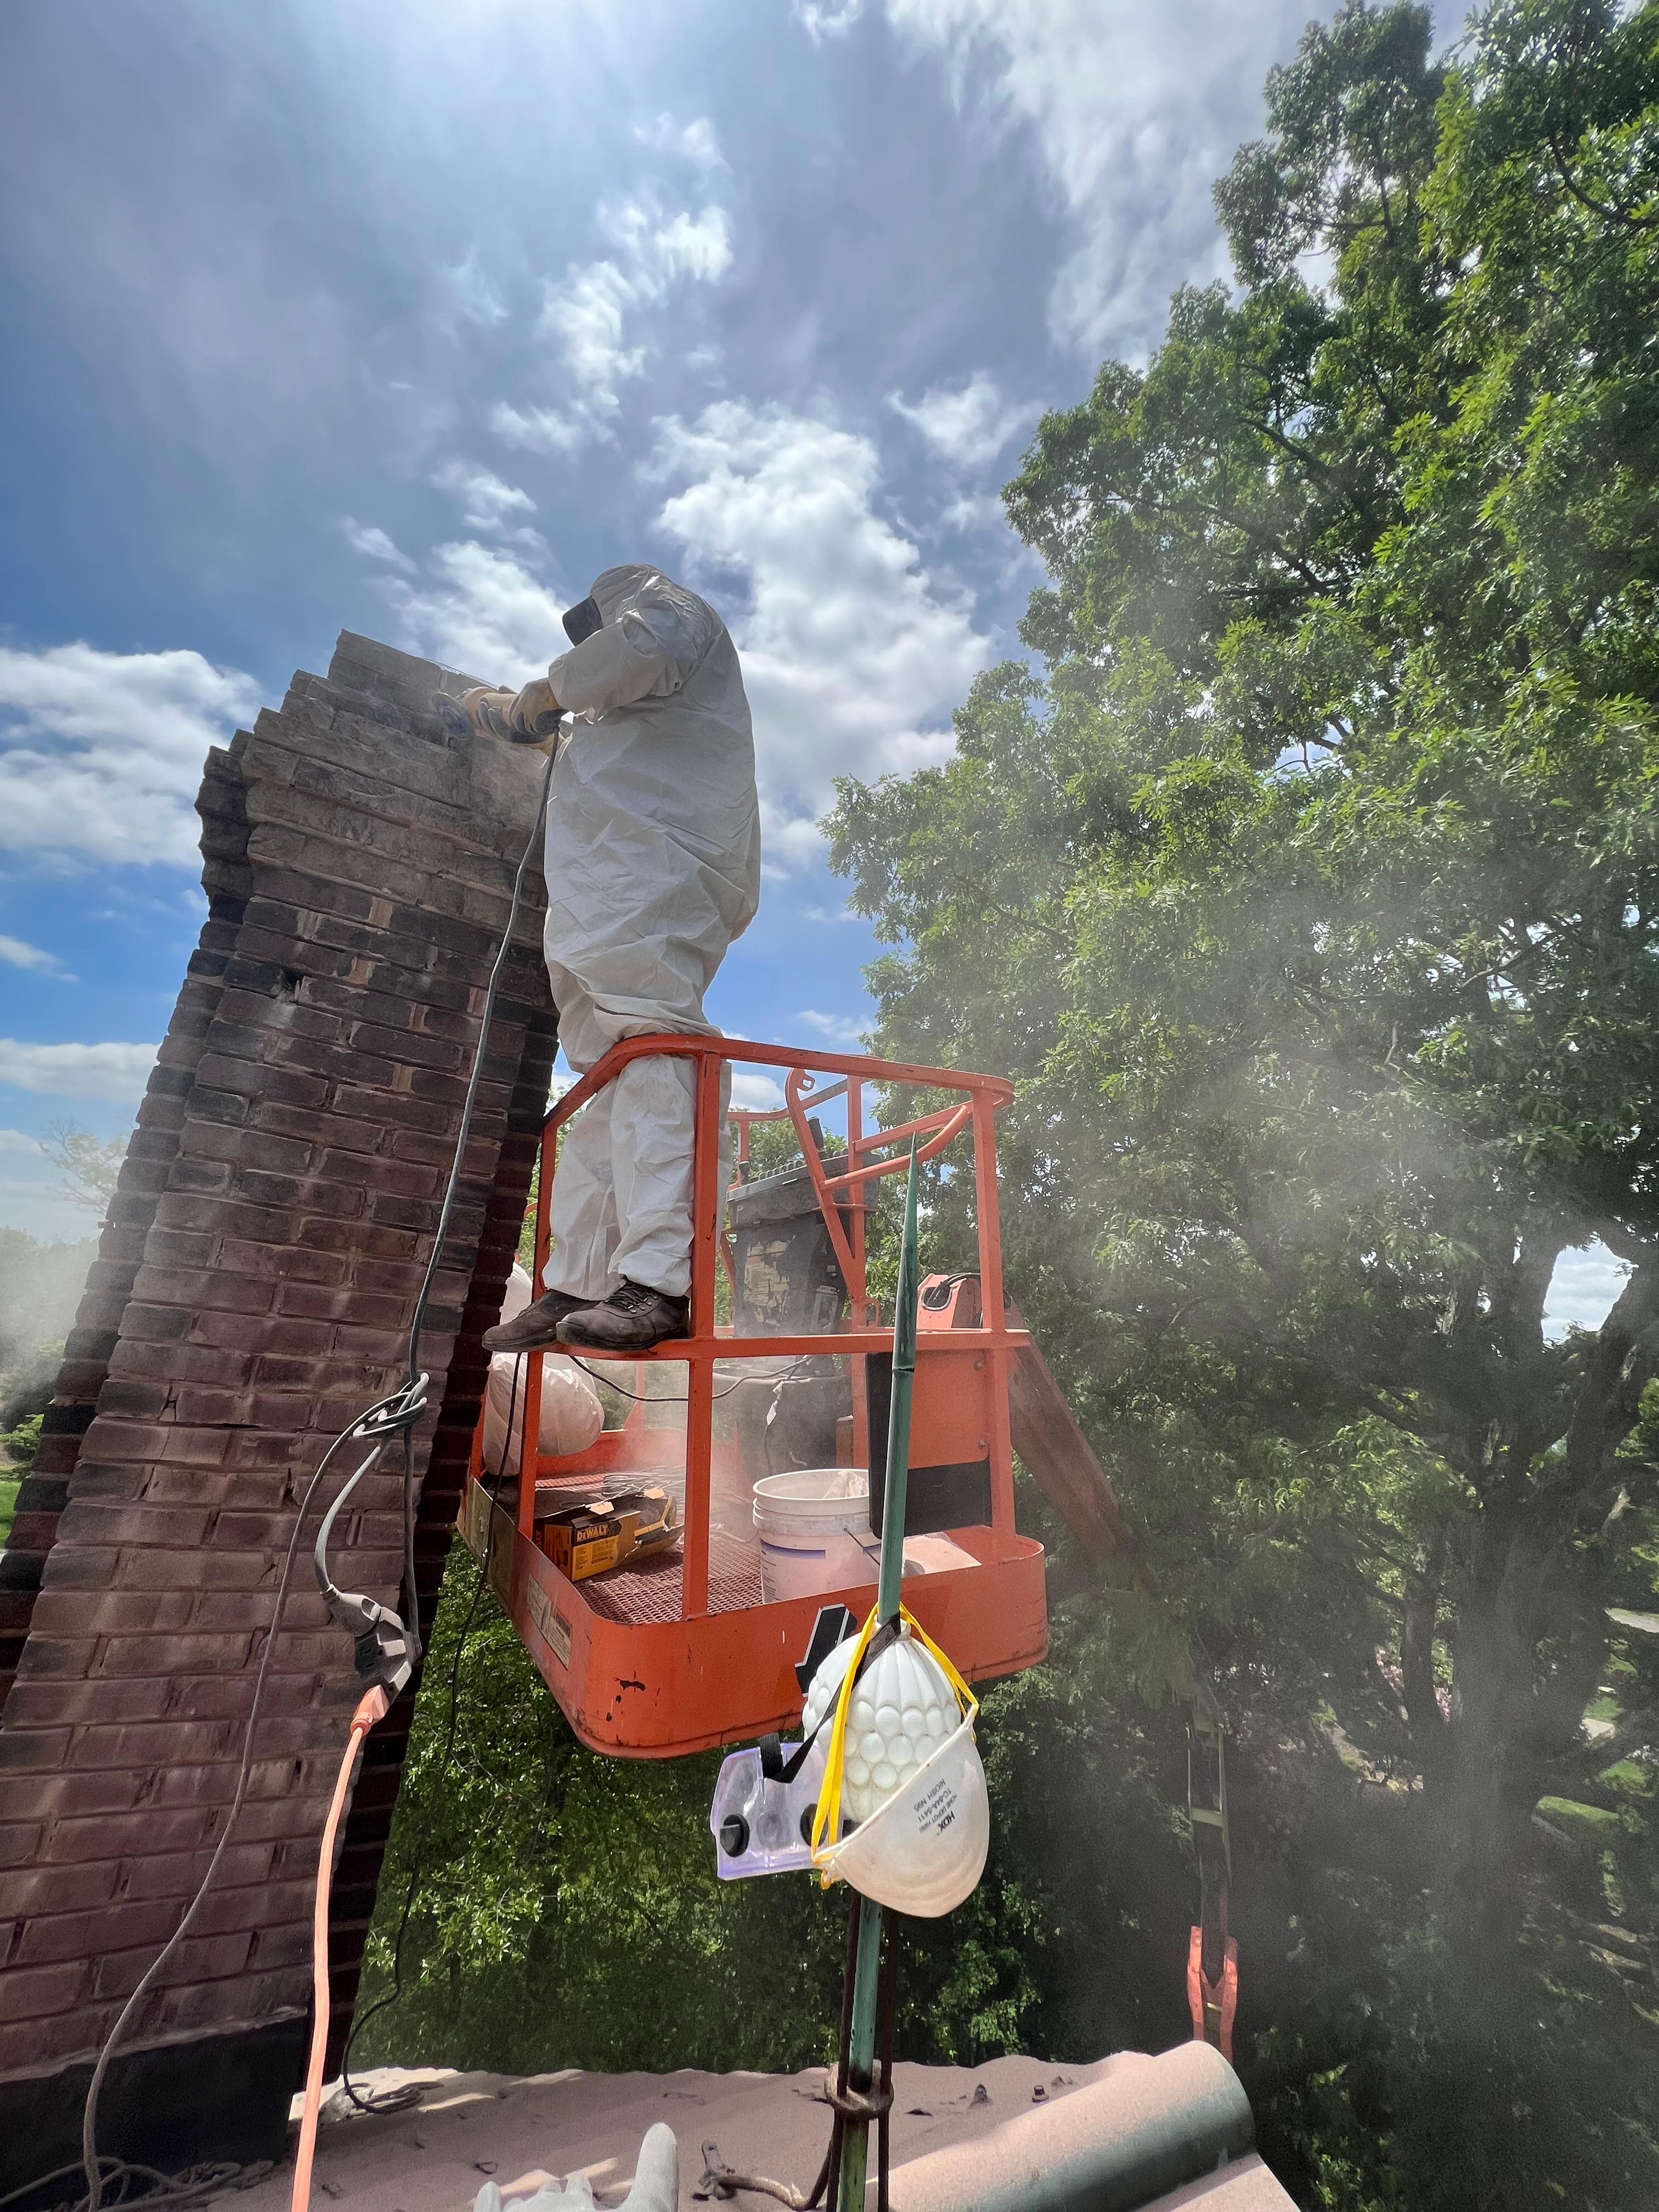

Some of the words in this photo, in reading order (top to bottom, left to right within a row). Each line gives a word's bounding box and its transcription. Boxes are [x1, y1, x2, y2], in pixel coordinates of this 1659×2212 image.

[927, 1778, 946, 1800] NIOSH
[913, 1798, 927, 1813] N95
[945, 1793, 957, 1809] HOME
[931, 1806, 947, 1822] DEPOT
[937, 1810, 956, 1832] HDX
